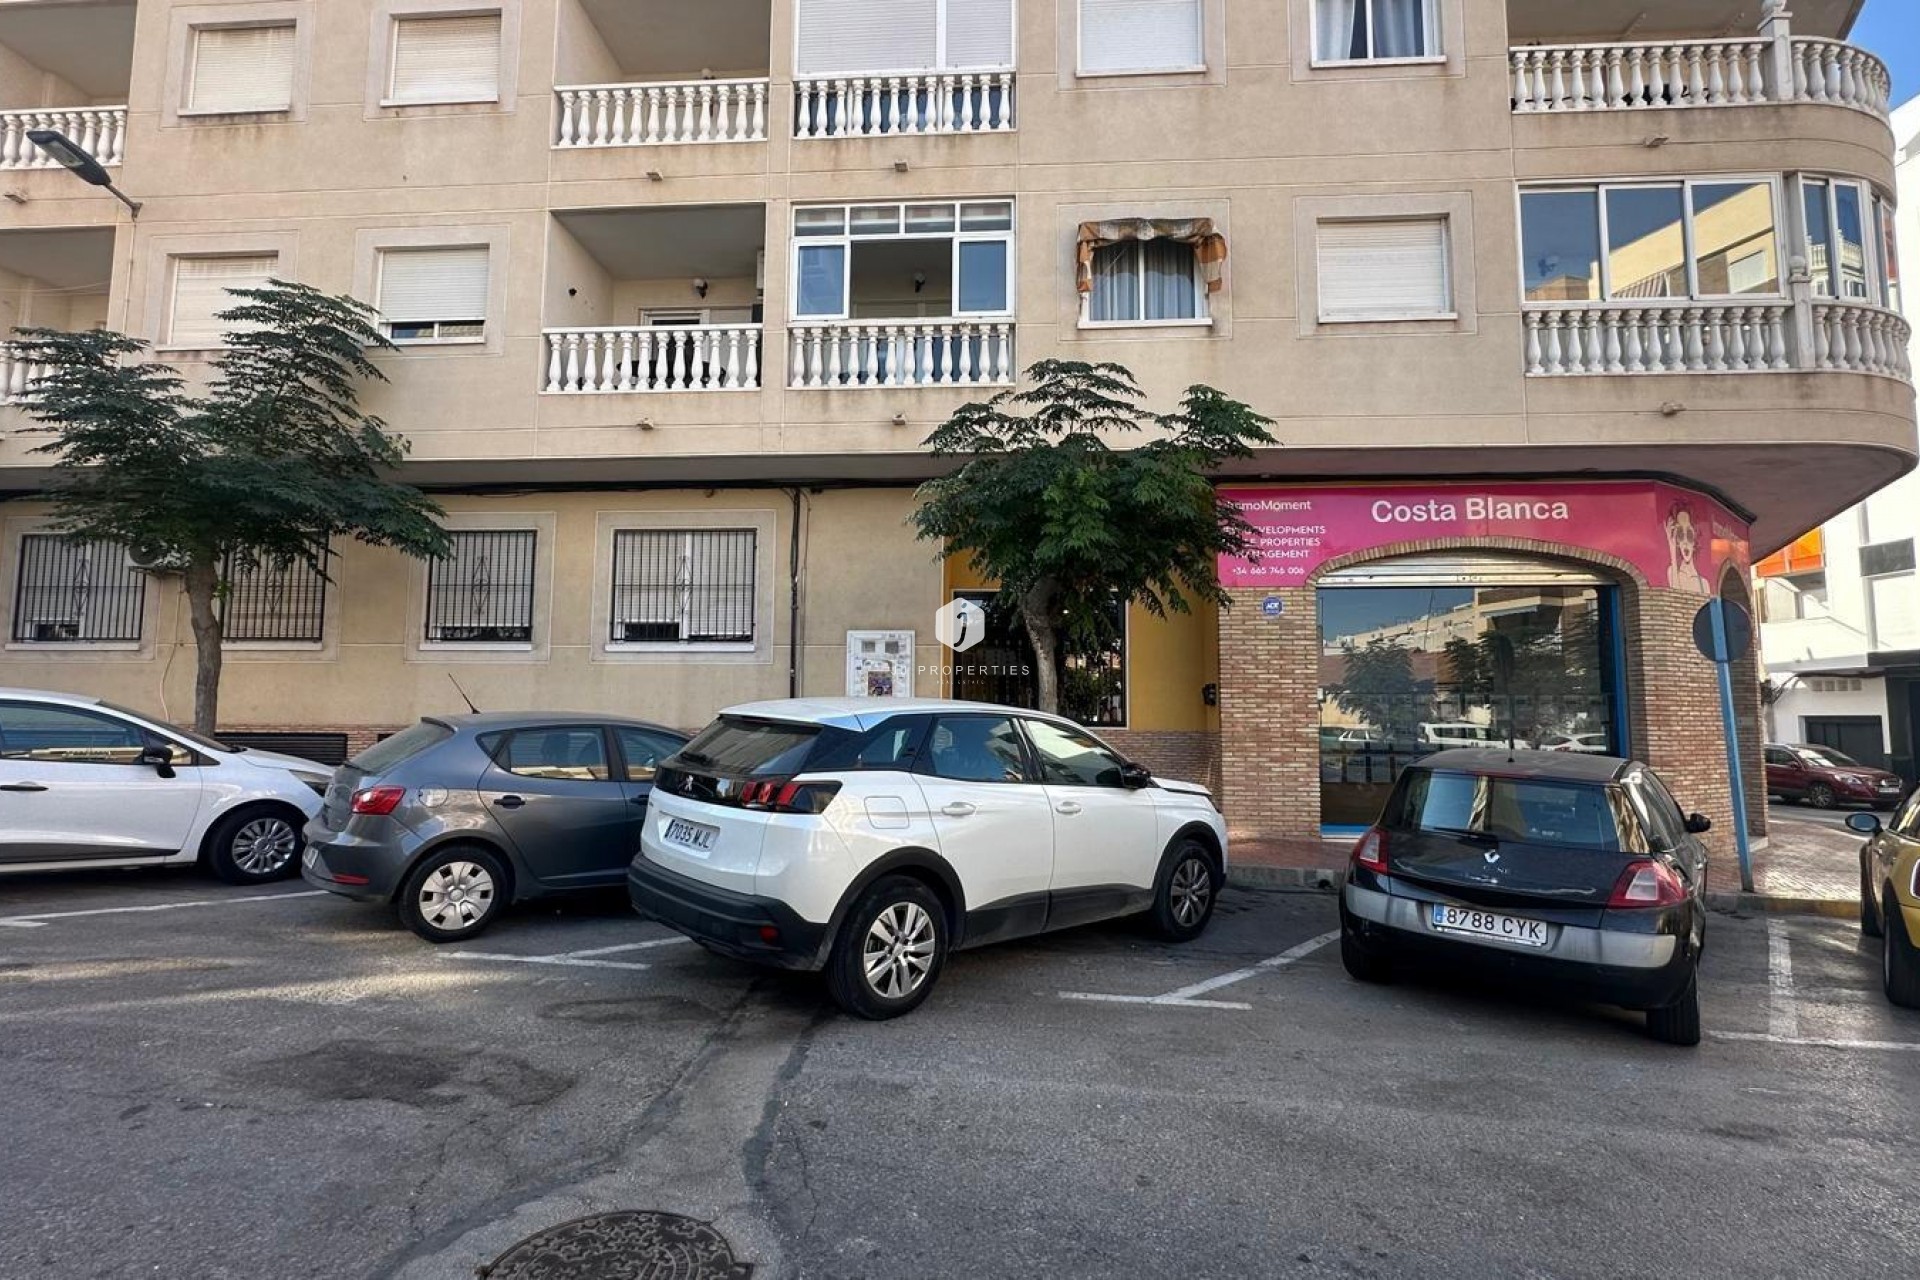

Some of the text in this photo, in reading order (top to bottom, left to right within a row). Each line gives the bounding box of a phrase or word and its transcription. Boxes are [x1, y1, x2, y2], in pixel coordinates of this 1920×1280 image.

[1371, 497, 1569, 523] Costa Blanca
[1260, 537, 1321, 547] PROPERTIES
[1446, 908, 1495, 930] 8788
[1501, 918, 1541, 940] CYK
